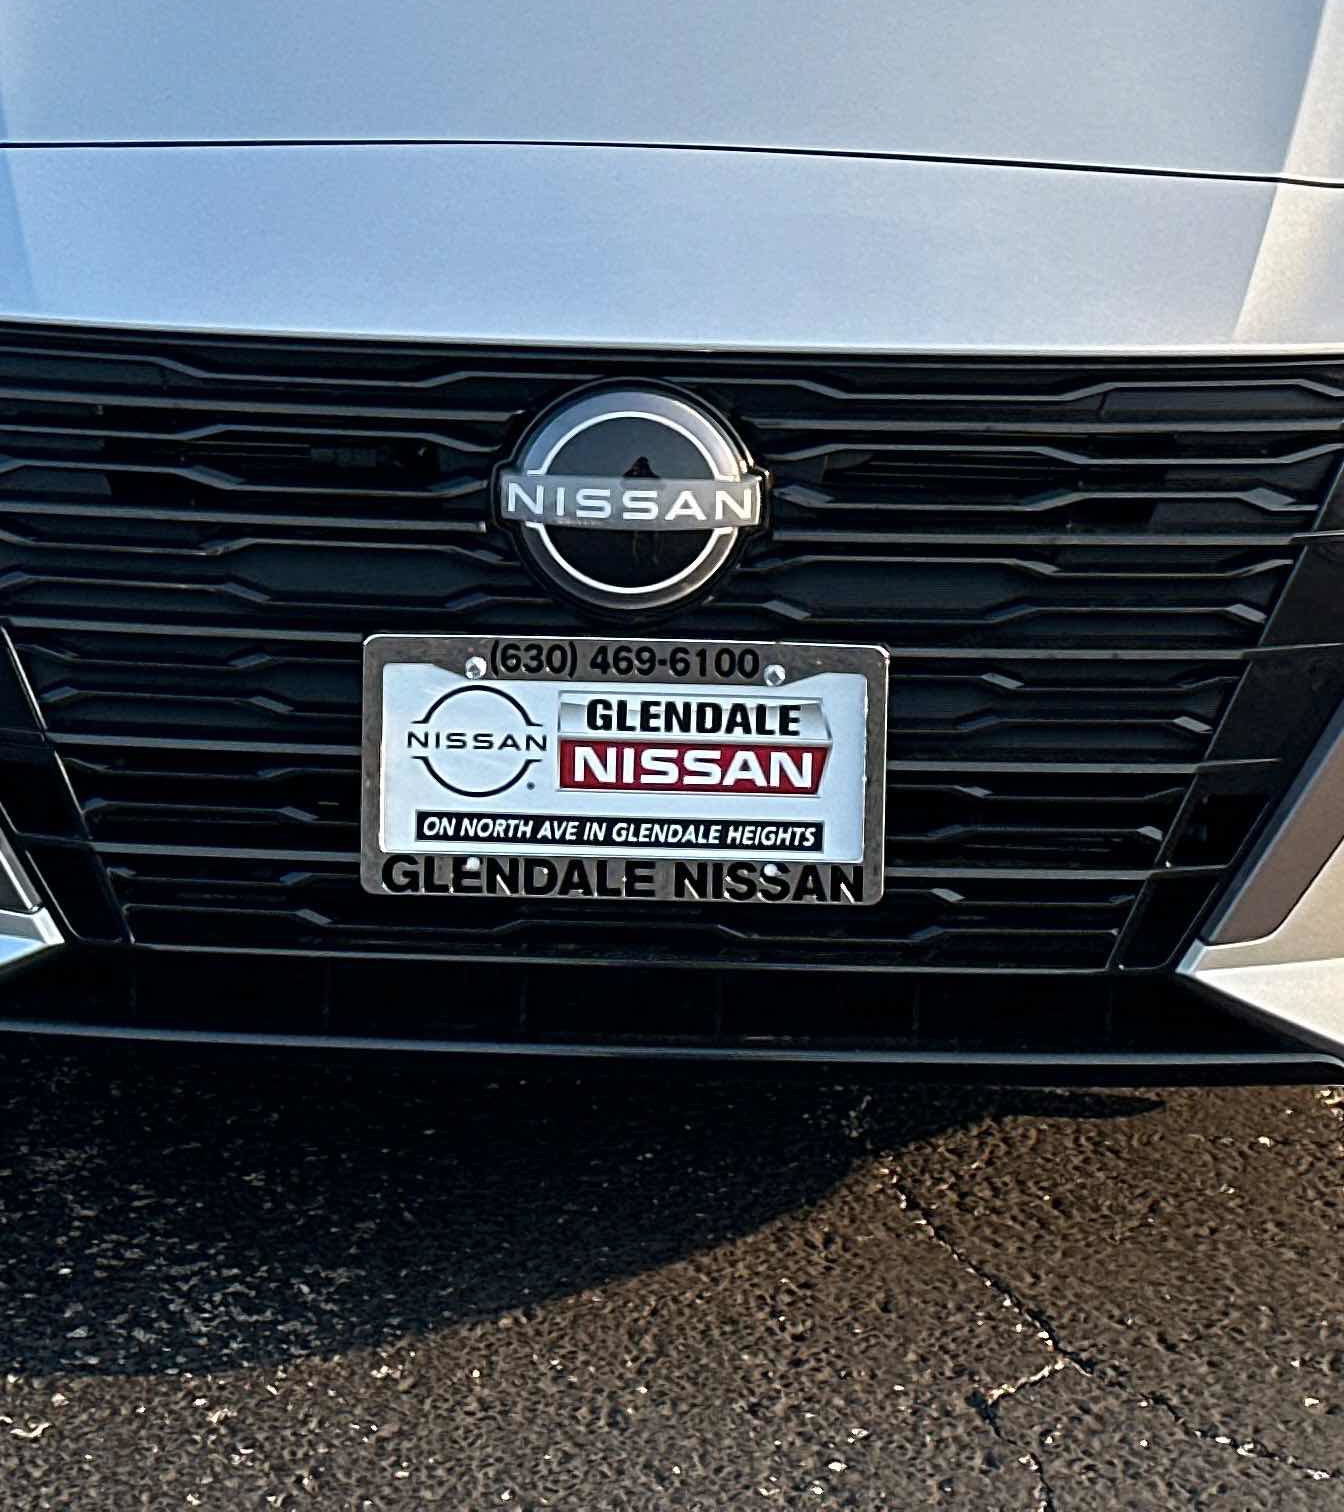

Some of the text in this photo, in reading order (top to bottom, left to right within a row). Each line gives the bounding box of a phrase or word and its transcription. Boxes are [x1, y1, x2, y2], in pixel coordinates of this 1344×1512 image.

[507, 482, 752, 521] NISSAN
[489, 640, 759, 679] (630) 469-6100
[586, 698, 801, 737] GLENDALE
[407, 730, 547, 752] NISSAN
[573, 746, 813, 788] NISSAN
[423, 816, 816, 847] ON NORTH AVE IN GLENDALE HEIGHTS
[381, 854, 864, 903] GLENDALE NISSAN
